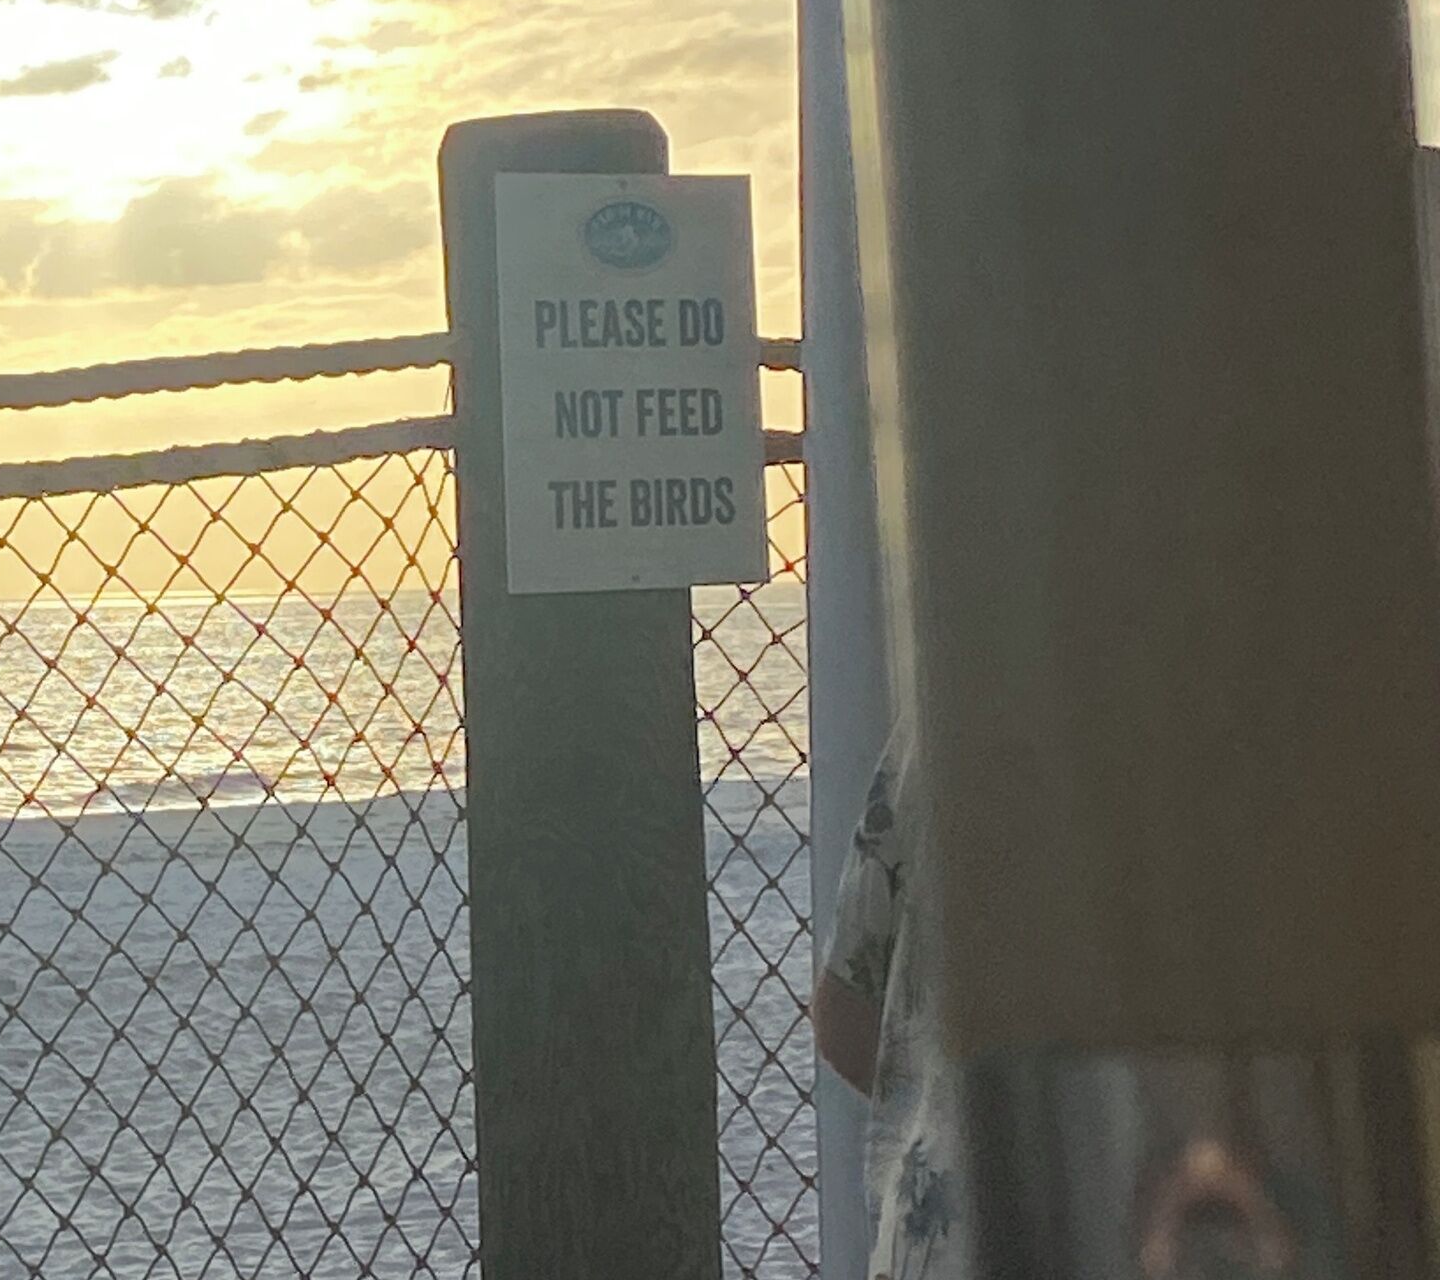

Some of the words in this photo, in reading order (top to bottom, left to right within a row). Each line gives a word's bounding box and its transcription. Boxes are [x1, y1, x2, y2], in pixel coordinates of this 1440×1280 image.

[535, 299, 666, 348] PLEASE
[679, 298, 725, 347] DO
[554, 389, 624, 439] NOT
[636, 389, 723, 437] FEED
[548, 481, 618, 530] THE
[630, 477, 737, 527] BIRDS
